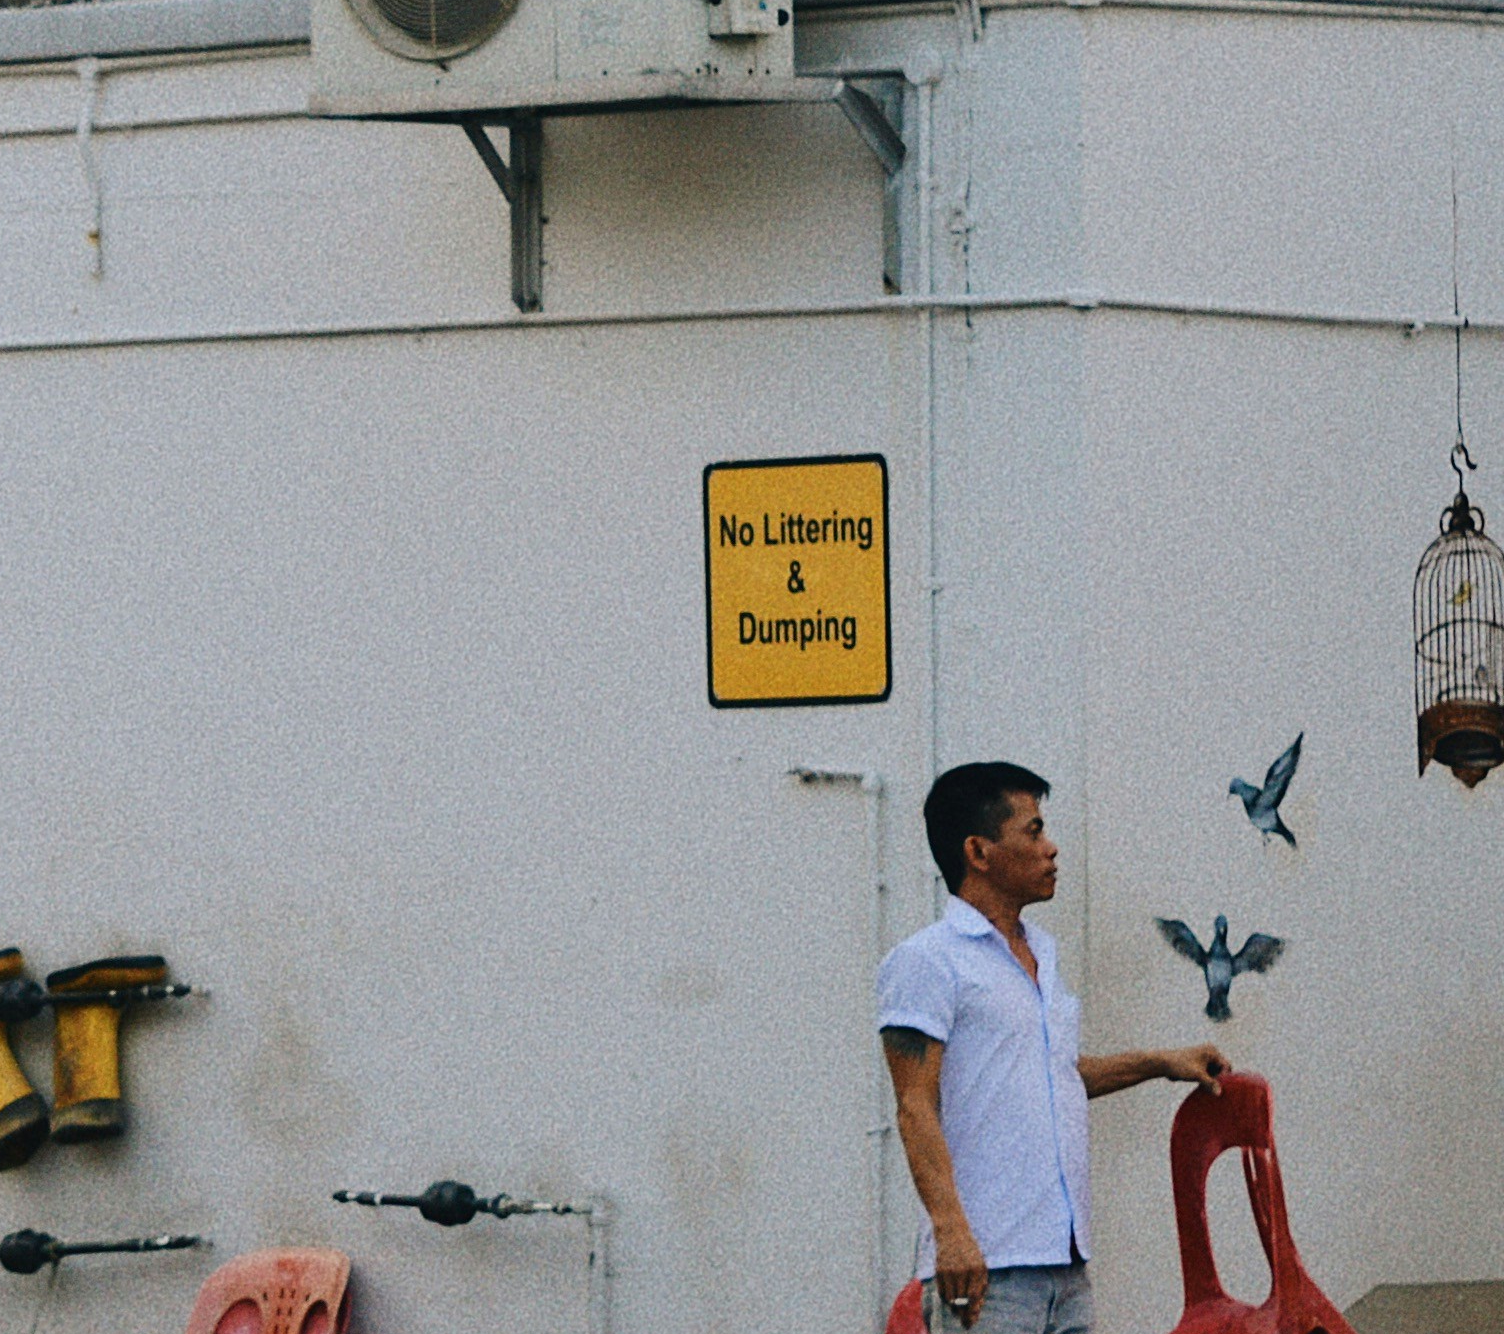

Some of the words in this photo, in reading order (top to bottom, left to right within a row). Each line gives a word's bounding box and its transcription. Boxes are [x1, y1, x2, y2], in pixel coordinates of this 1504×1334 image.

[719, 514, 754, 547] No
[763, 509, 873, 550] Littering
[787, 560, 805, 593] &
[739, 608, 856, 651] Dumping
